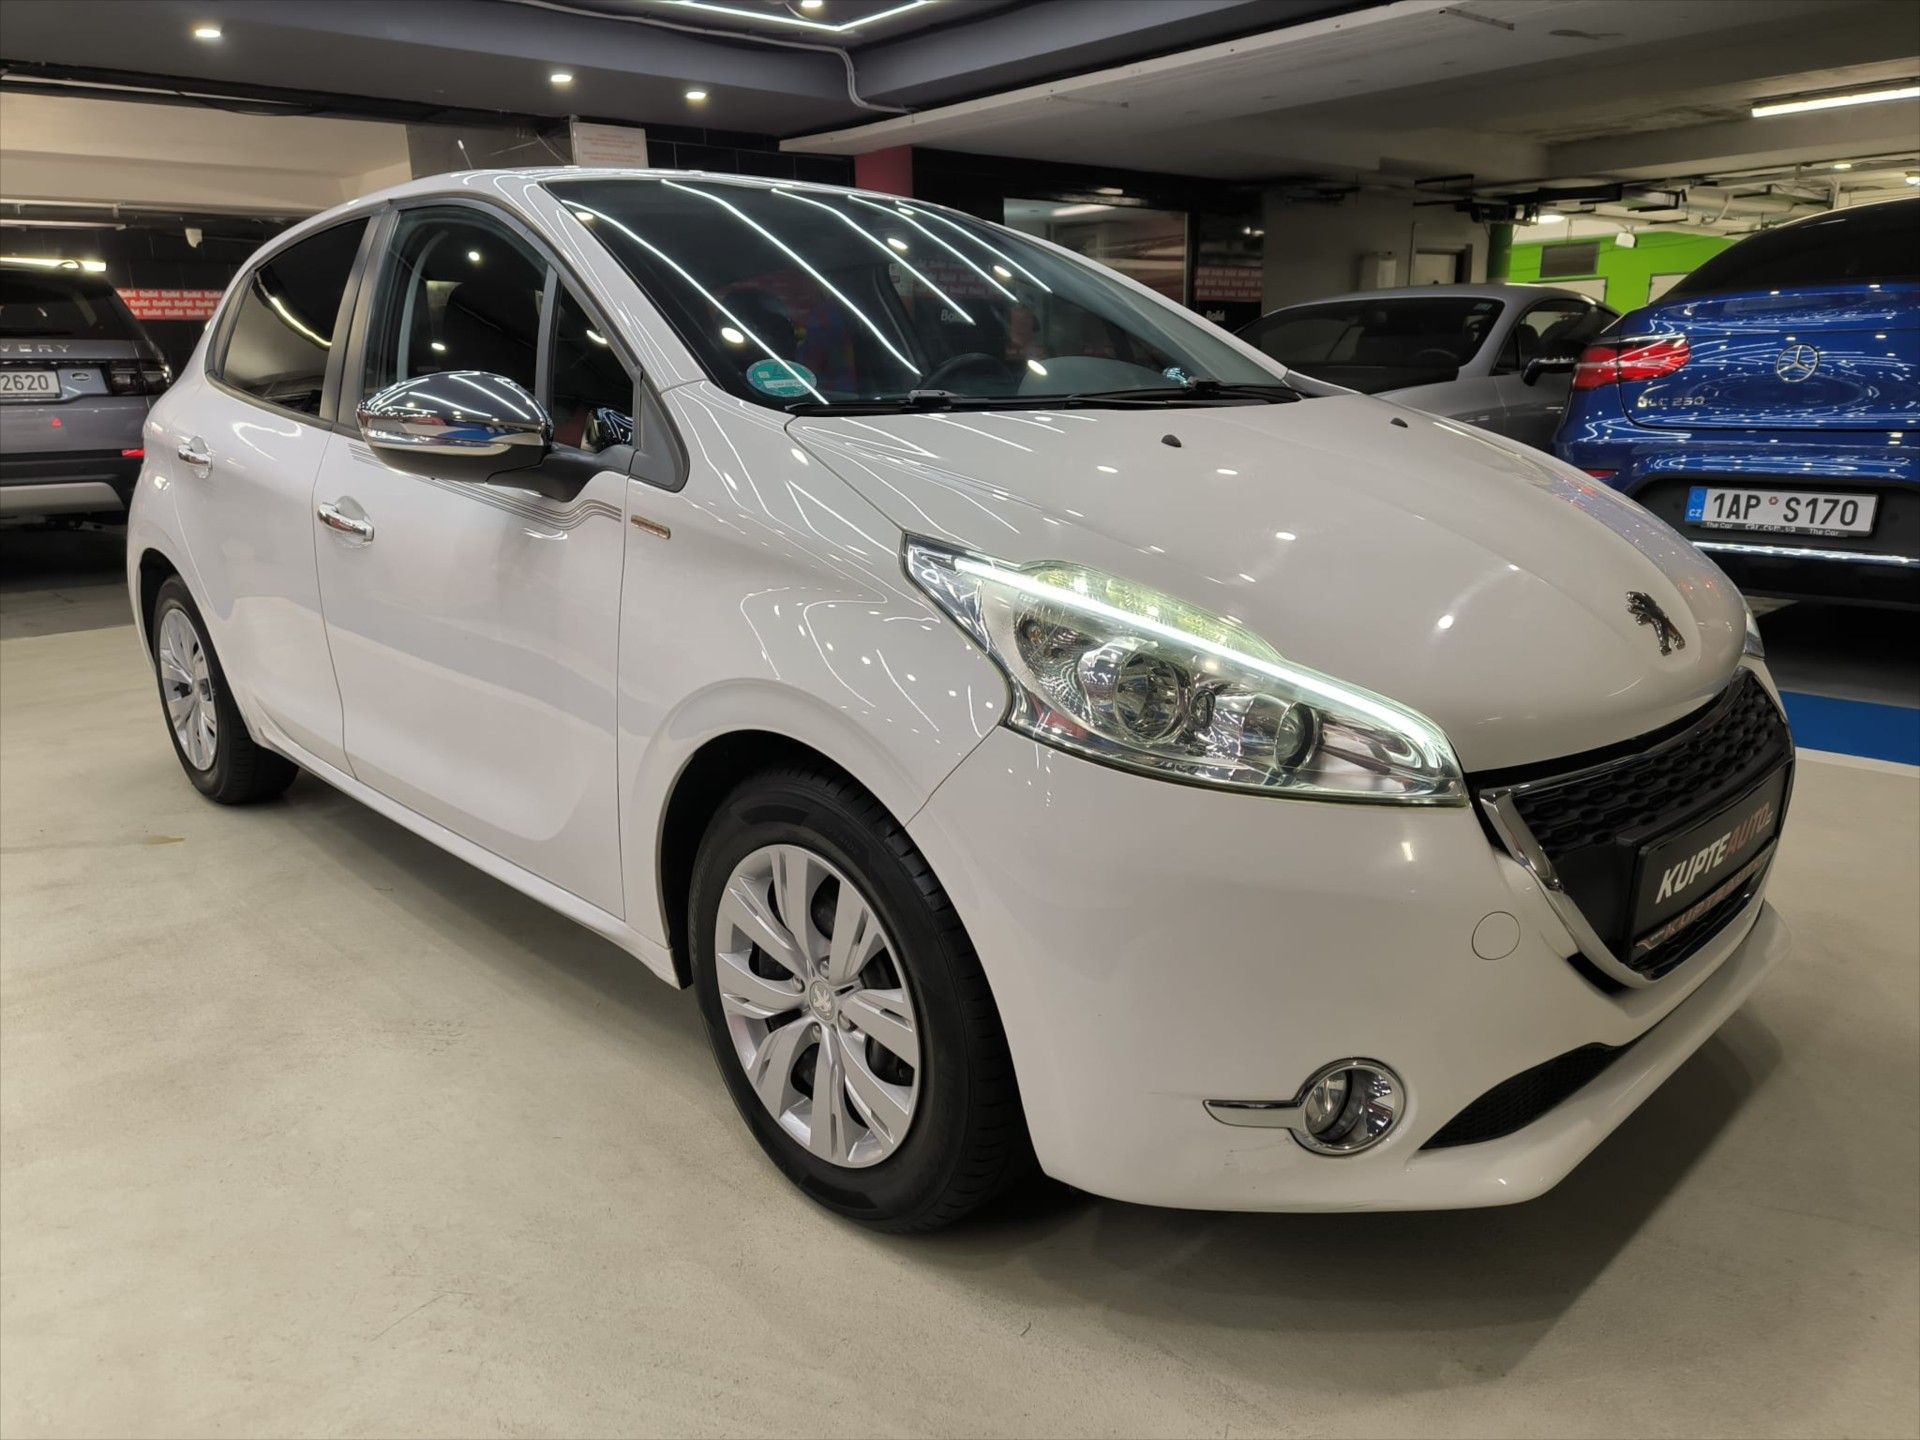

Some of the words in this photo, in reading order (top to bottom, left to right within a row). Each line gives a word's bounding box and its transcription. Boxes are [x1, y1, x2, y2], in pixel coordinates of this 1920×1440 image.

[0, 374, 49, 391] 2620
[1672, 396, 1706, 406] 250
[1689, 508, 1702, 518] CZ
[1713, 493, 1761, 520] 1AP
[1782, 497, 1859, 527] S170
